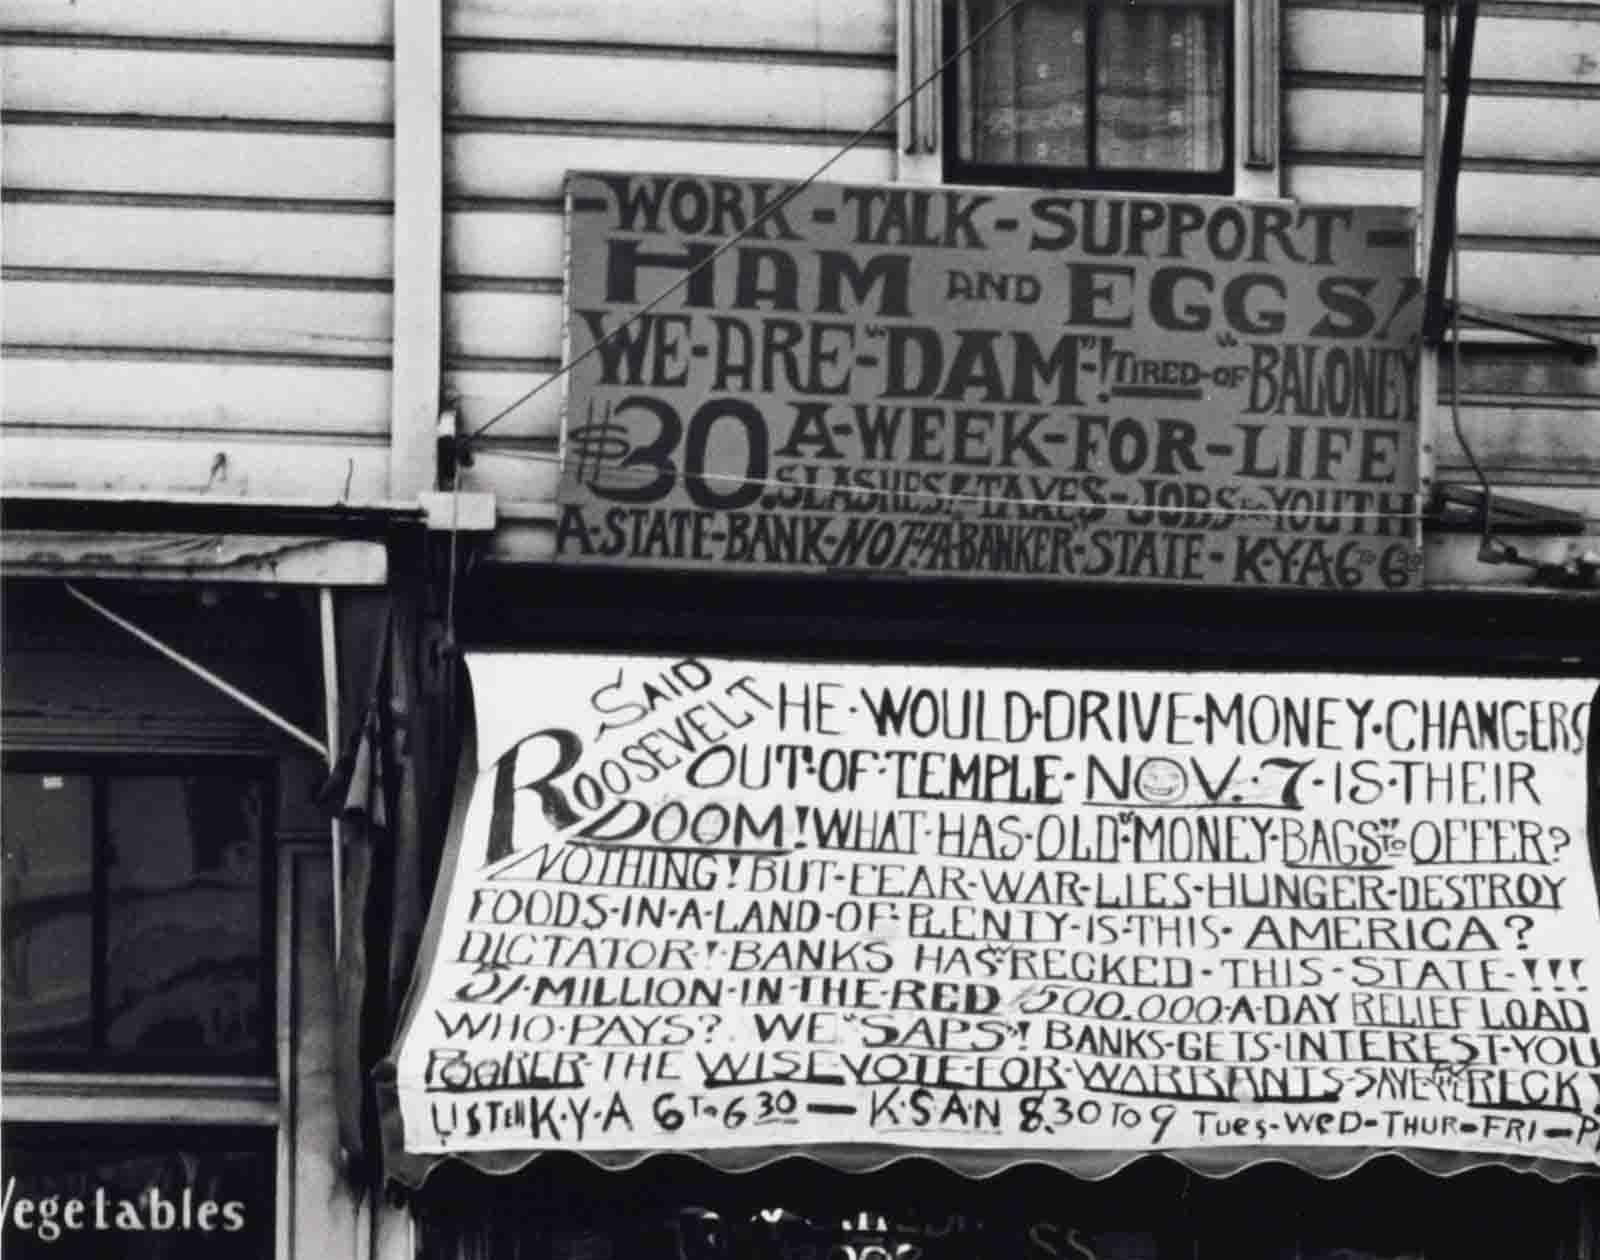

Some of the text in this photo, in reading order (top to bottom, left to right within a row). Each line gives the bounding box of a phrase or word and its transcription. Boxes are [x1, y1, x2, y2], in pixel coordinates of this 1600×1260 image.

[607, 176, 1352, 264] WORK TALK SUPPORT
[604, 239, 912, 317] HAM
[947, 269, 1042, 304] AND
[707, 315, 854, 396] ARE
[852, 405, 1052, 467] WEEK
[1070, 415, 1204, 475] FOR
[1234, 423, 1399, 483] LIFE
[780, 681, 845, 736] HE
[861, 686, 1034, 743] WOULD
[1044, 688, 1194, 745] DRIVE
[1206, 691, 1374, 752] MONEY
[1387, 698, 1592, 756] CHANGERS
[885, 748, 1541, 806] TEMPLE IS THEIR
[813, 808, 1024, 861] WHAT HAS
[749, 854, 1567, 911] BUT FEAR WAR LIES HUNGER DESTROY
[467, 889, 1221, 950] FOODS IN LAND OF PLENTY IS THIS
[727, 938, 894, 973] BANKS
[1220, 958, 1323, 990] THIS
[530, 975, 1592, 1033] MILLION IN THE RED DAY RELIEF LOAD
[434, 1009, 555, 1042] WHO
[753, 1013, 837, 1045] WE
[1045, 1019, 1165, 1060] BANKS
[1176, 1030, 1270, 1064] GETS
[1285, 1030, 1501, 1067] INTEREST
[603, 1050, 1345, 1104] THE VOTE FOR WARRANTS
